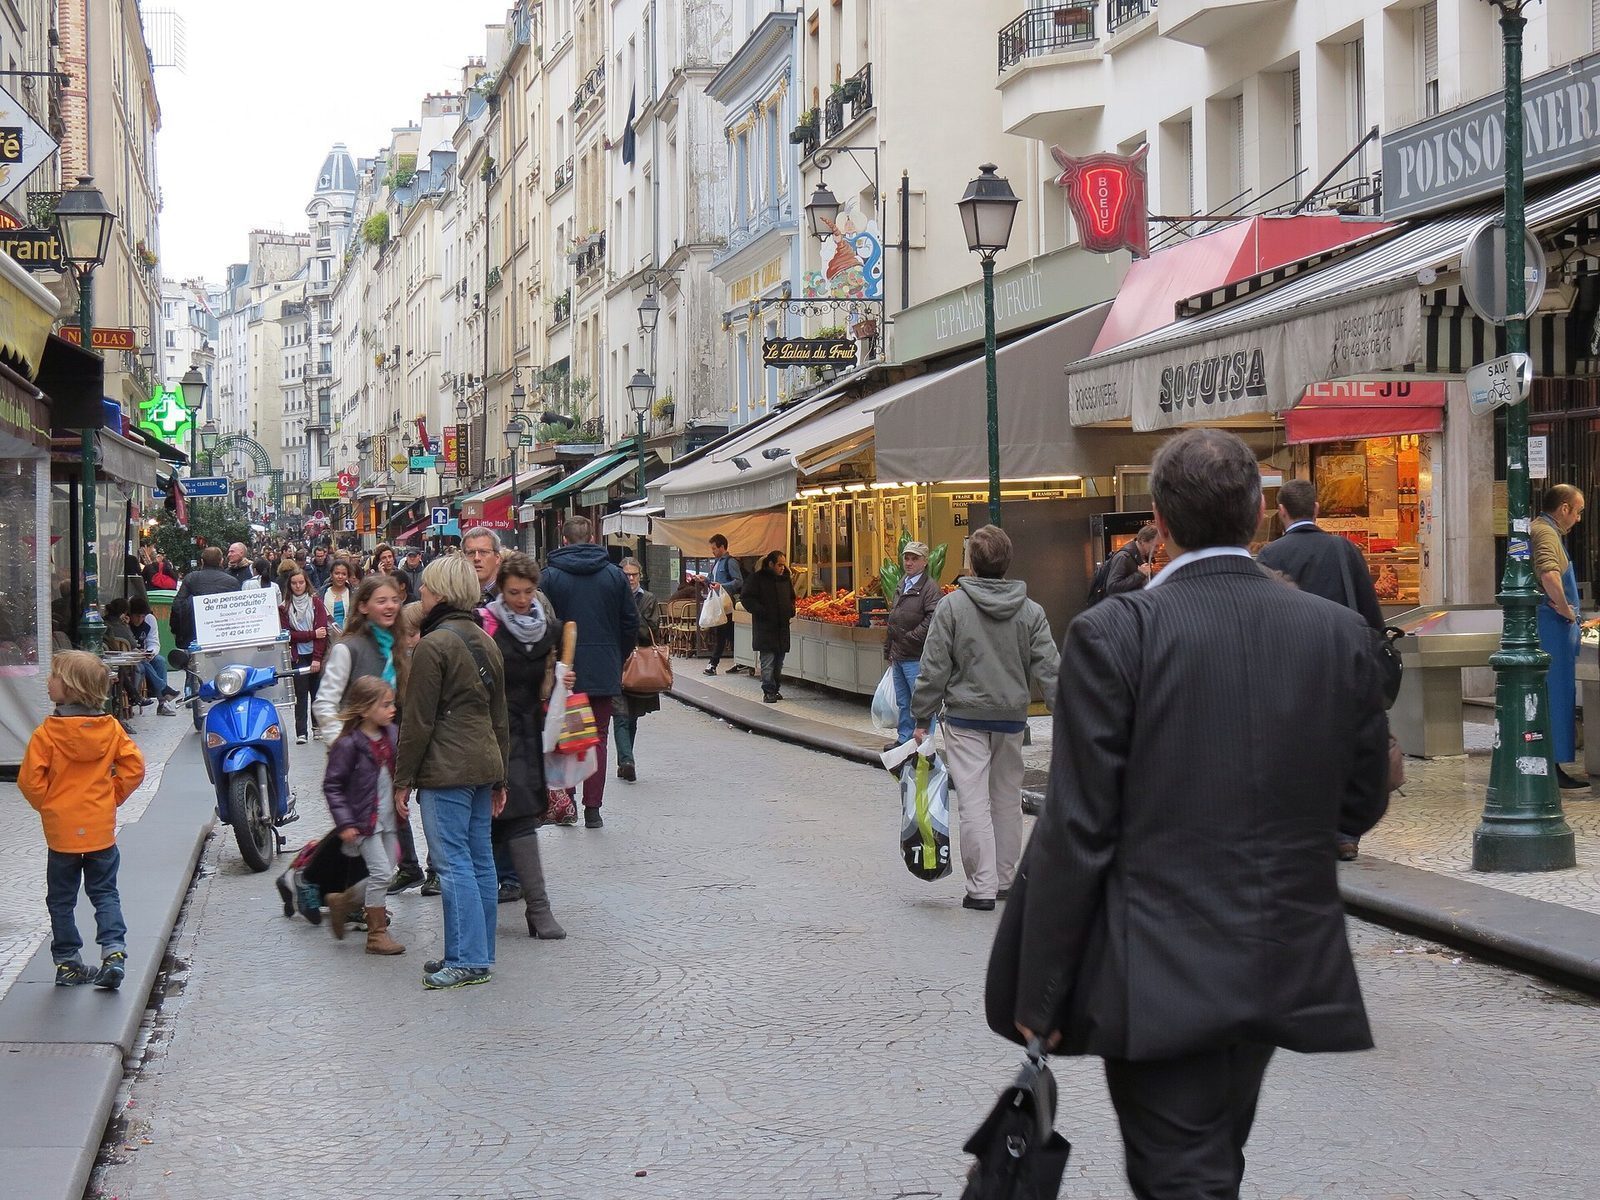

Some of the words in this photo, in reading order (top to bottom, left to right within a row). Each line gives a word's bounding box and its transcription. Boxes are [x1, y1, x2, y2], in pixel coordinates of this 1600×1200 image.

[1098, 177, 1109, 229] BOEUF
[934, 308, 948, 340] LE
[1005, 272, 1043, 317] FRUIT
[67, 331, 127, 345] NIOLAS
[764, 344, 779, 359] Le
[780, 343, 811, 359] Palais
[811, 344, 827, 359] du
[828, 343, 856, 359] Fruit
[1487, 360, 1509, 377] SAUF
[1159, 347, 1268, 413] SOGUISA
[495, 520, 510, 528] Italy
[203, 597, 218, 605] Que
[219, 592, 267, 605] pensez-vous
